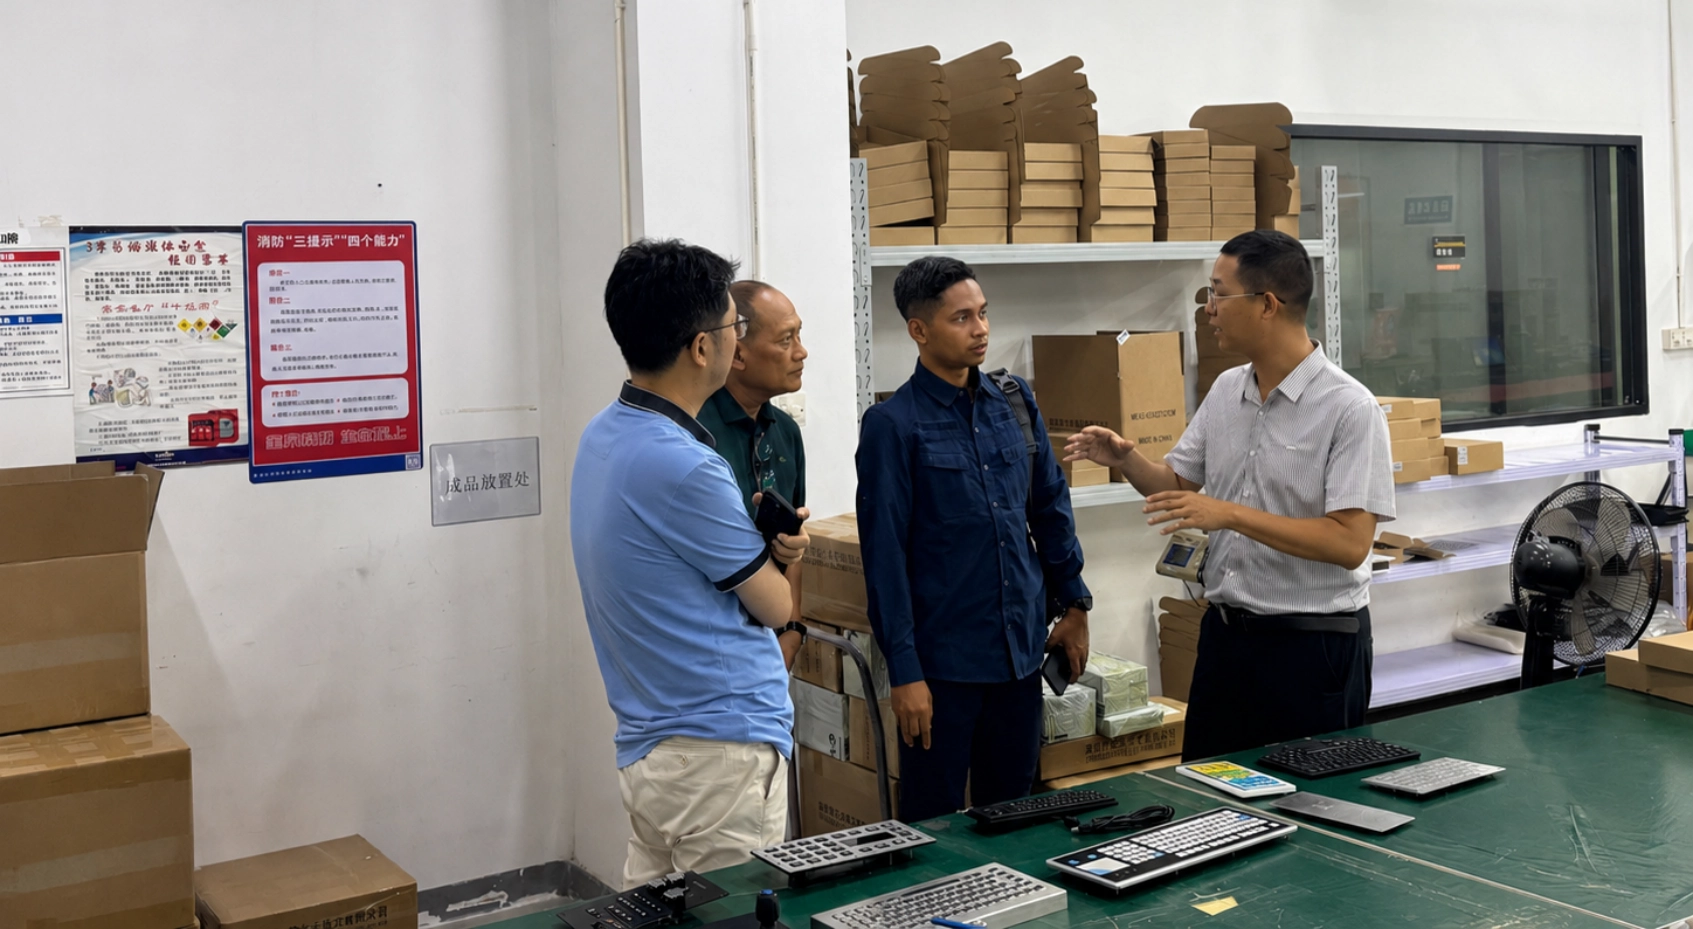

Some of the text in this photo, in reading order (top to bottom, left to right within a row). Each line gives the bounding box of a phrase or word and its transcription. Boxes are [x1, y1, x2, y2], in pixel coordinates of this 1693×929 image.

[445, 471, 530, 495] 成品放置处
